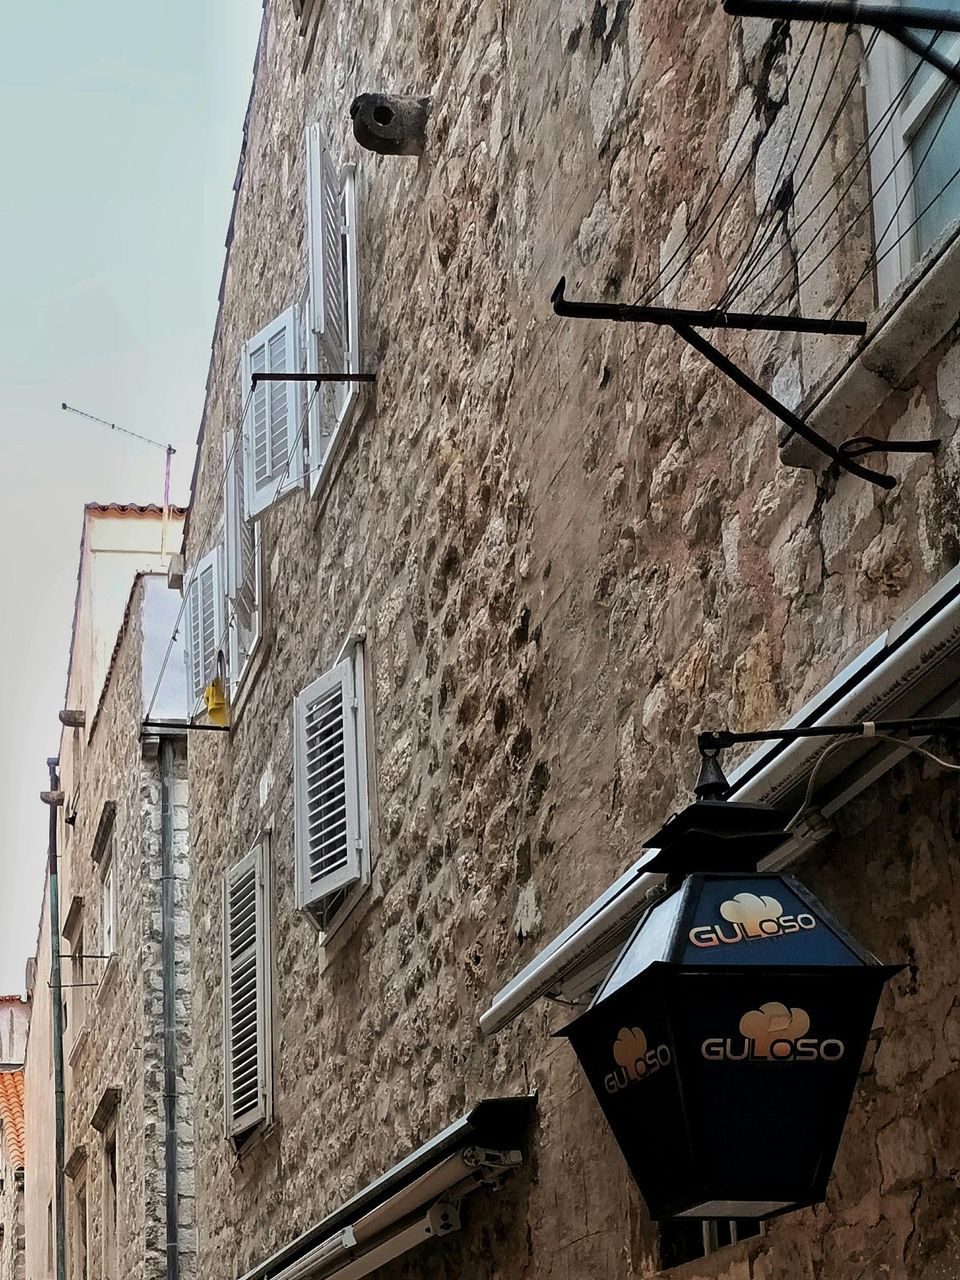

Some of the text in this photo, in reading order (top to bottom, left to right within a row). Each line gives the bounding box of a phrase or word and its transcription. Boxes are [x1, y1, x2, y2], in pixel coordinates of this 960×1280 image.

[688, 913, 817, 948] GULOSO
[701, 1037, 845, 1062] GULOSO
[604, 1043, 671, 1094] GULOSO
